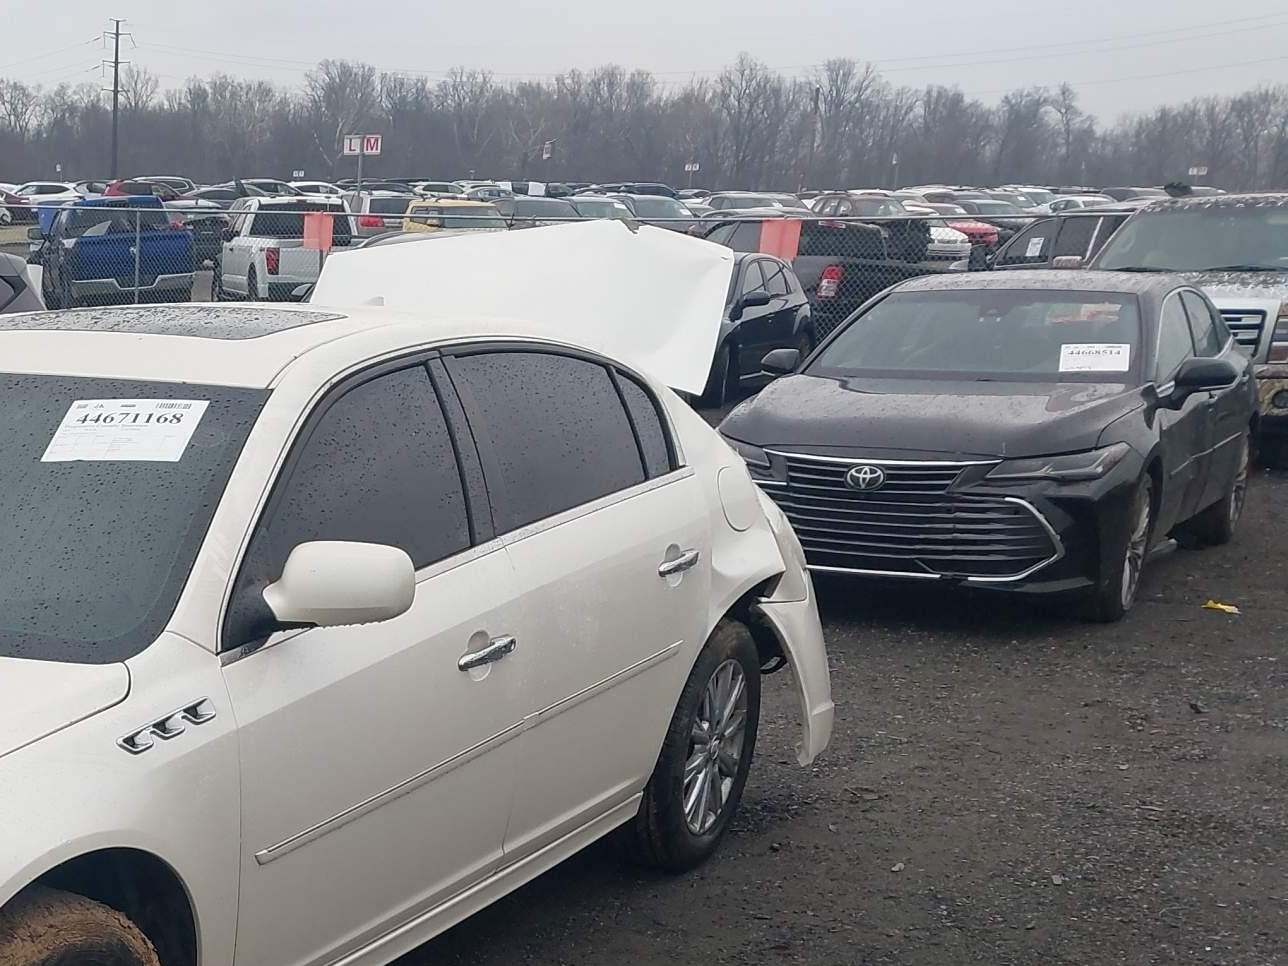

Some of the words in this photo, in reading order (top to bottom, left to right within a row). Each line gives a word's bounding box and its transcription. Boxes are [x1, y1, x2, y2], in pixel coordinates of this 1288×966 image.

[348, 138, 357, 152] L
[365, 137, 379, 152] M
[75, 412, 185, 425] 44671168
